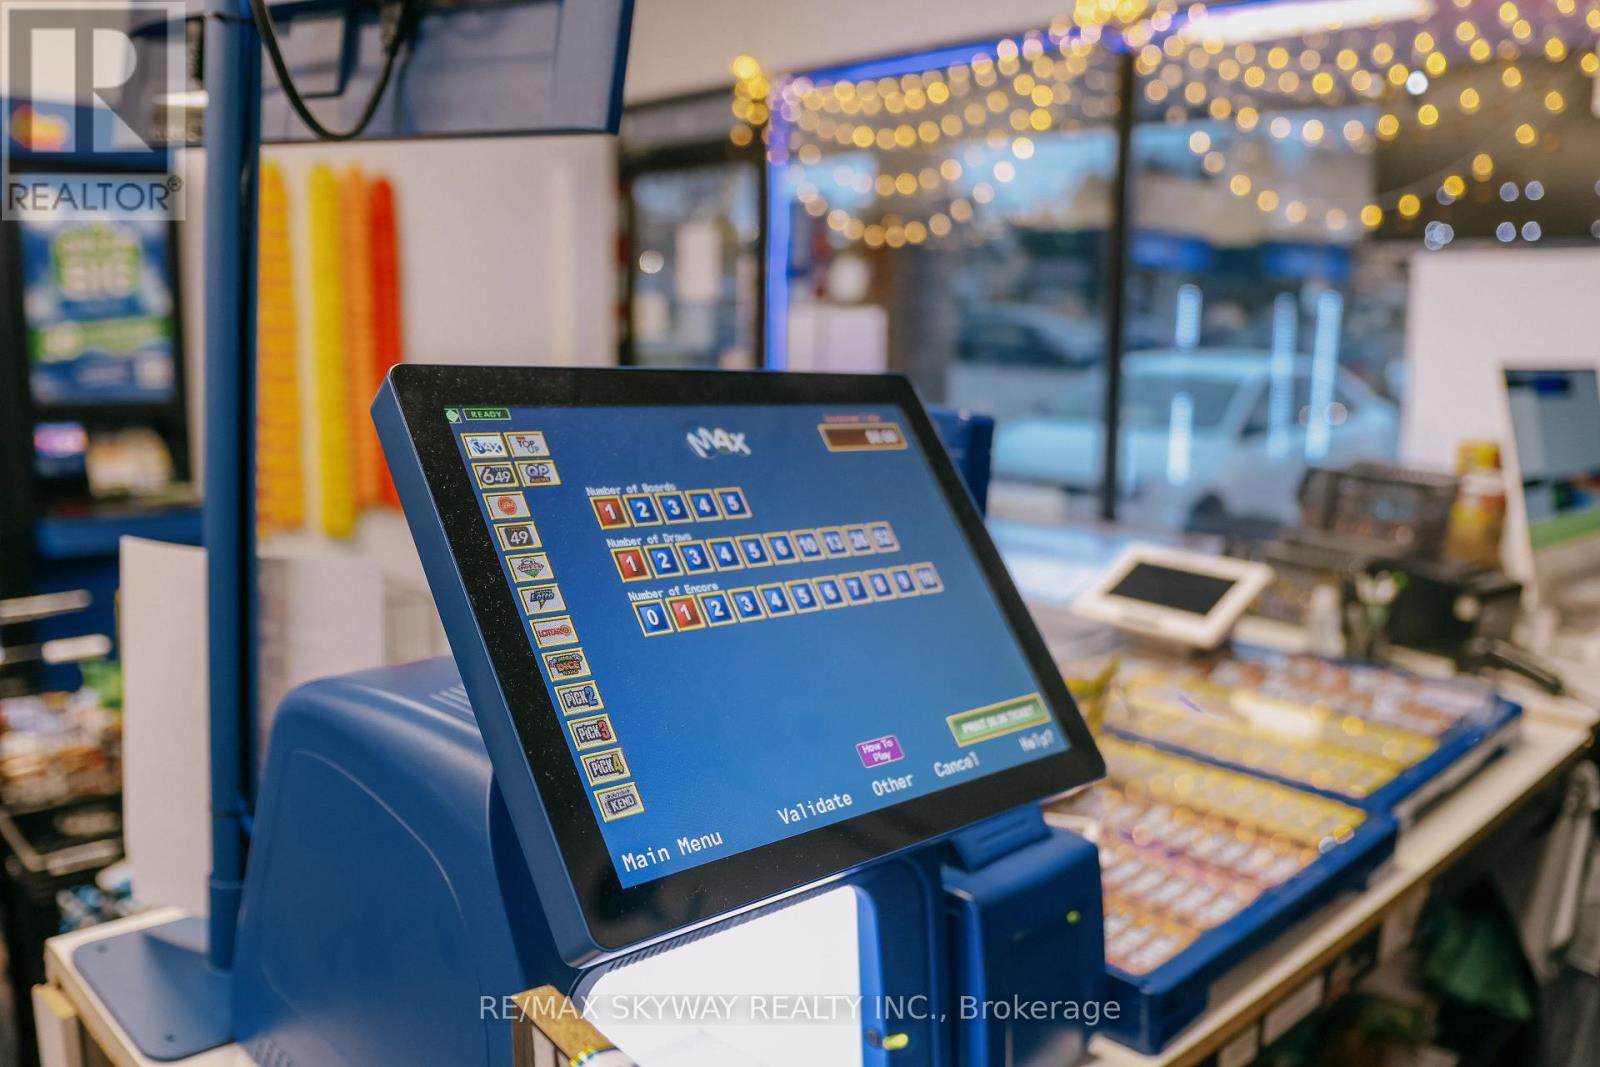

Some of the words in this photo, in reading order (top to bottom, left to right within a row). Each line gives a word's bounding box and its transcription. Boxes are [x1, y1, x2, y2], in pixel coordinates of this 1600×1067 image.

[518, 440, 535, 448] TOP
[687, 427, 751, 459] MAX
[585, 485, 621, 497] Number
[626, 484, 638, 493] of
[642, 481, 677, 493] Boards
[605, 504, 616, 520] 1
[636, 502, 650, 518] 2
[667, 500, 681, 515] 3
[699, 498, 711, 513] 4
[726, 496, 740, 511] 5
[510, 531, 528, 544] 49
[606, 537, 642, 549] Number
[647, 535, 659, 545] of
[626, 555, 638, 572] 1
[657, 553, 671, 569] 2
[688, 550, 701, 565] 3
[720, 547, 732, 562] 4
[748, 543, 761, 559] 5
[628, 591, 664, 602] Number
[669, 586, 680, 597] of
[646, 609, 660, 626] 0
[680, 604, 692, 621] 1
[710, 600, 725, 617] 2
[740, 596, 754, 612] 3
[771, 592, 783, 607] 4
[798, 587, 811, 604] 5
[823, 582, 837, 599] 6
[862, 742, 880, 753] How
[882, 739, 893, 748] To
[872, 751, 891, 762] Play
[933, 752, 980, 778] Cancel
[871, 774, 913, 796] Other
[777, 793, 853, 825] Validate
[622, 847, 670, 872] Main
[677, 832, 723, 855] Menu
